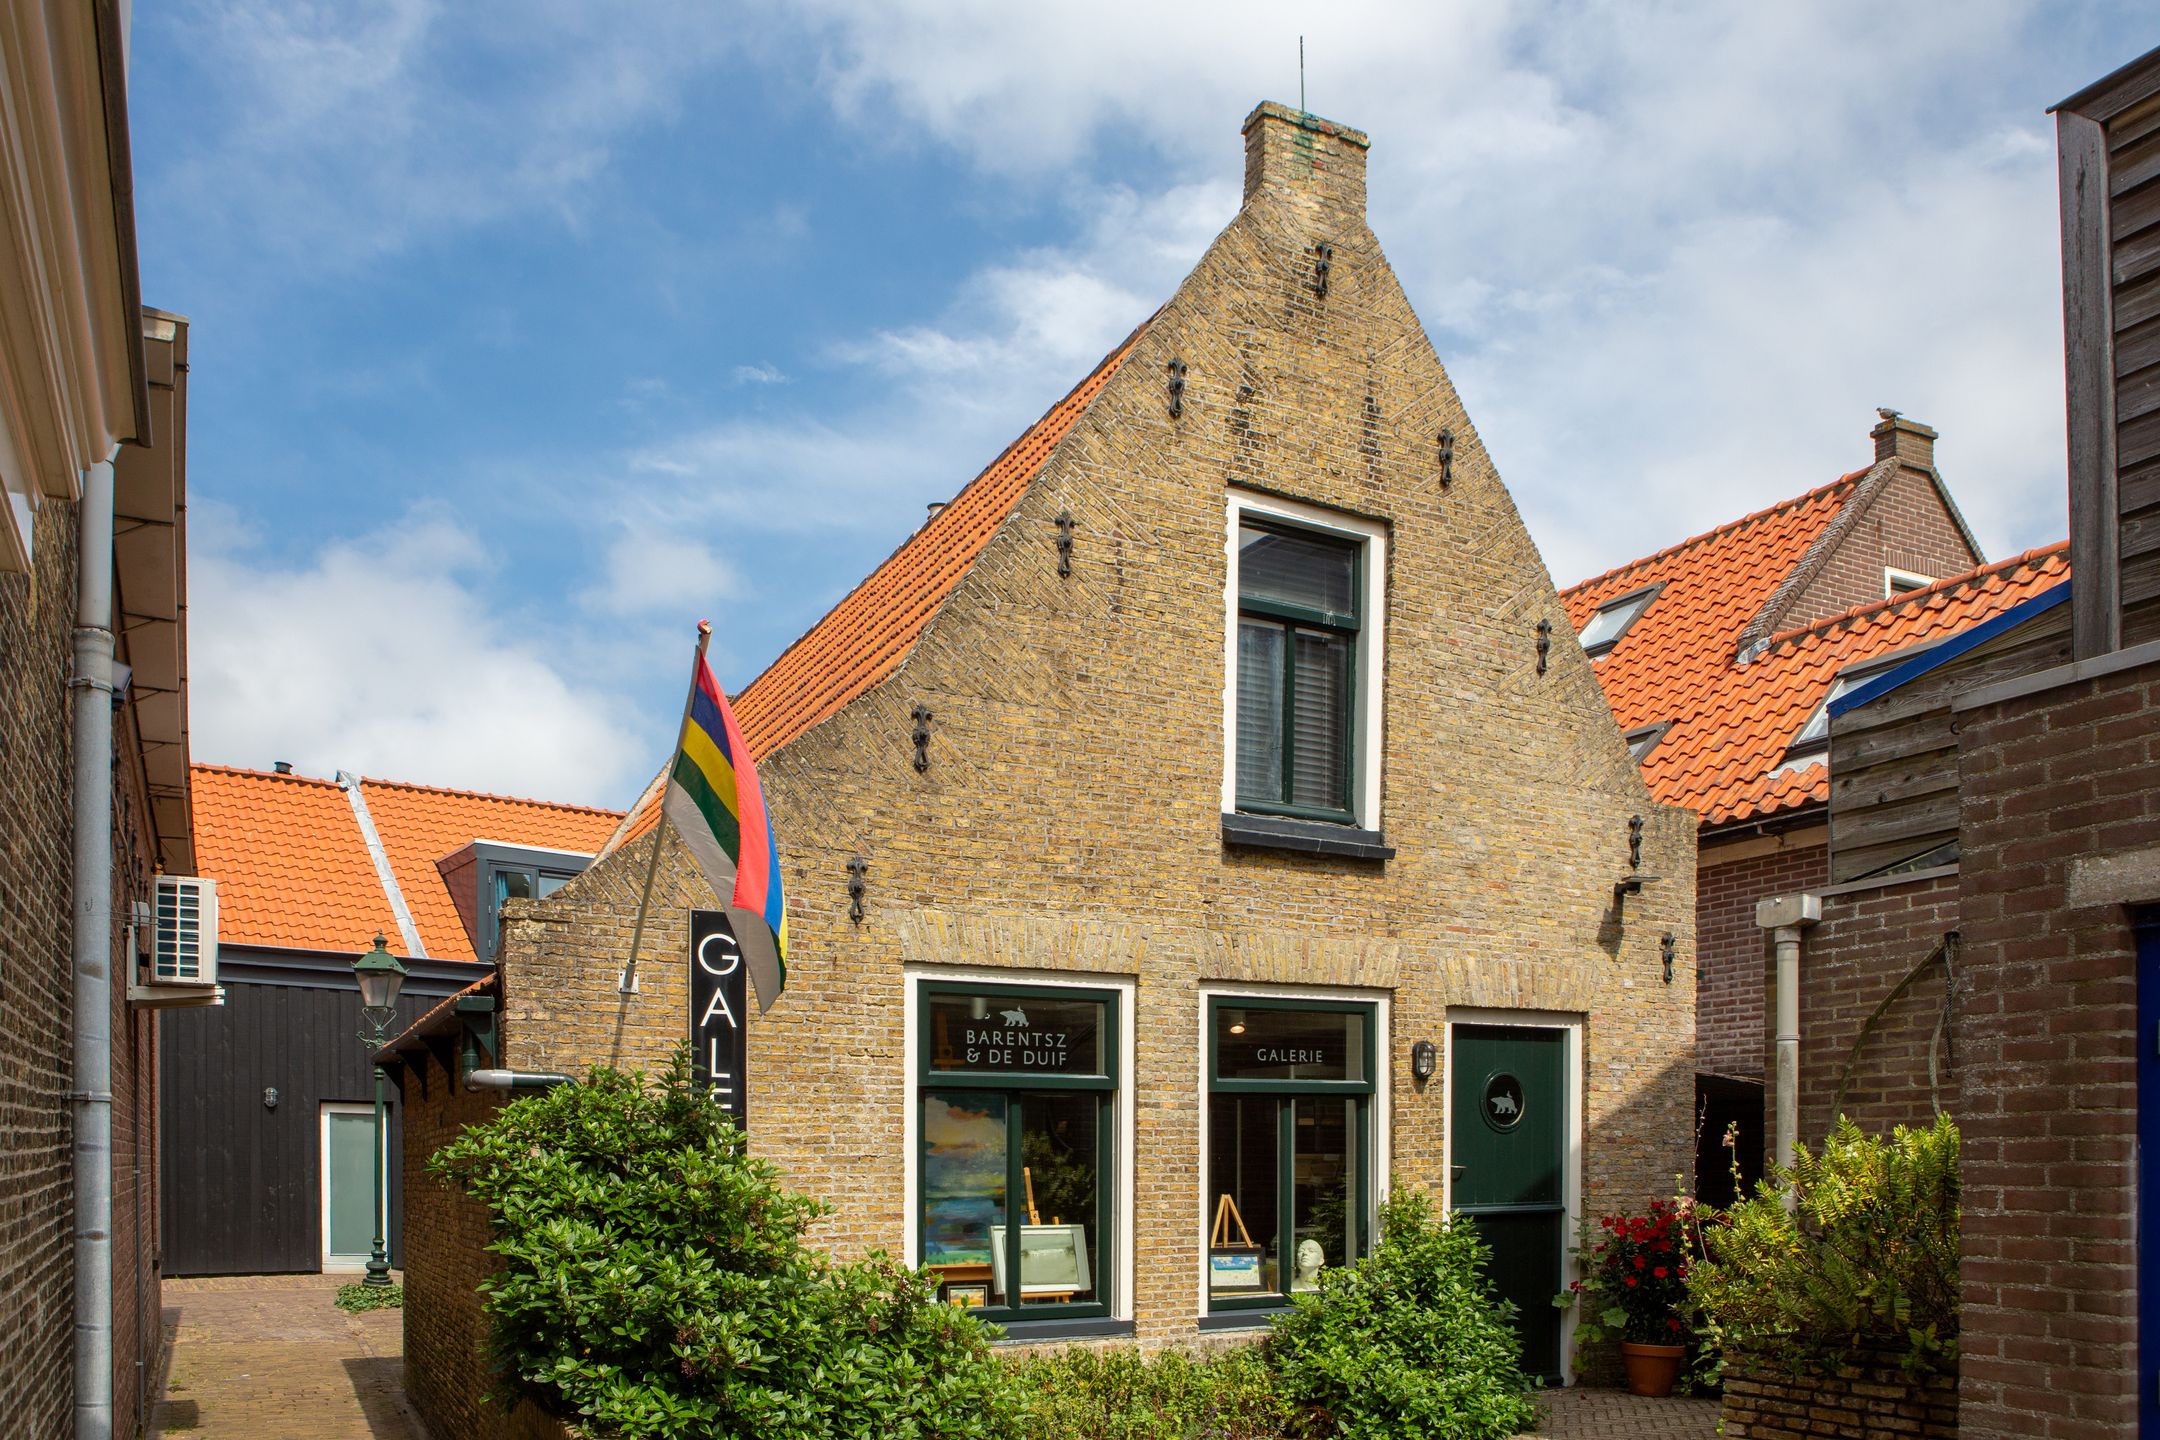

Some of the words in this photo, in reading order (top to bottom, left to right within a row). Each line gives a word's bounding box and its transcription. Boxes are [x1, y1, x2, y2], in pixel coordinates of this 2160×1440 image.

[698, 933, 739, 1158] GALE
[966, 1029, 1067, 1048] BARENTSZ
[966, 1048, 981, 1063] &
[989, 1049, 1013, 1064] DE
[1023, 1050, 1067, 1066] DUIF
[1256, 1048, 1323, 1063] GALERIE
